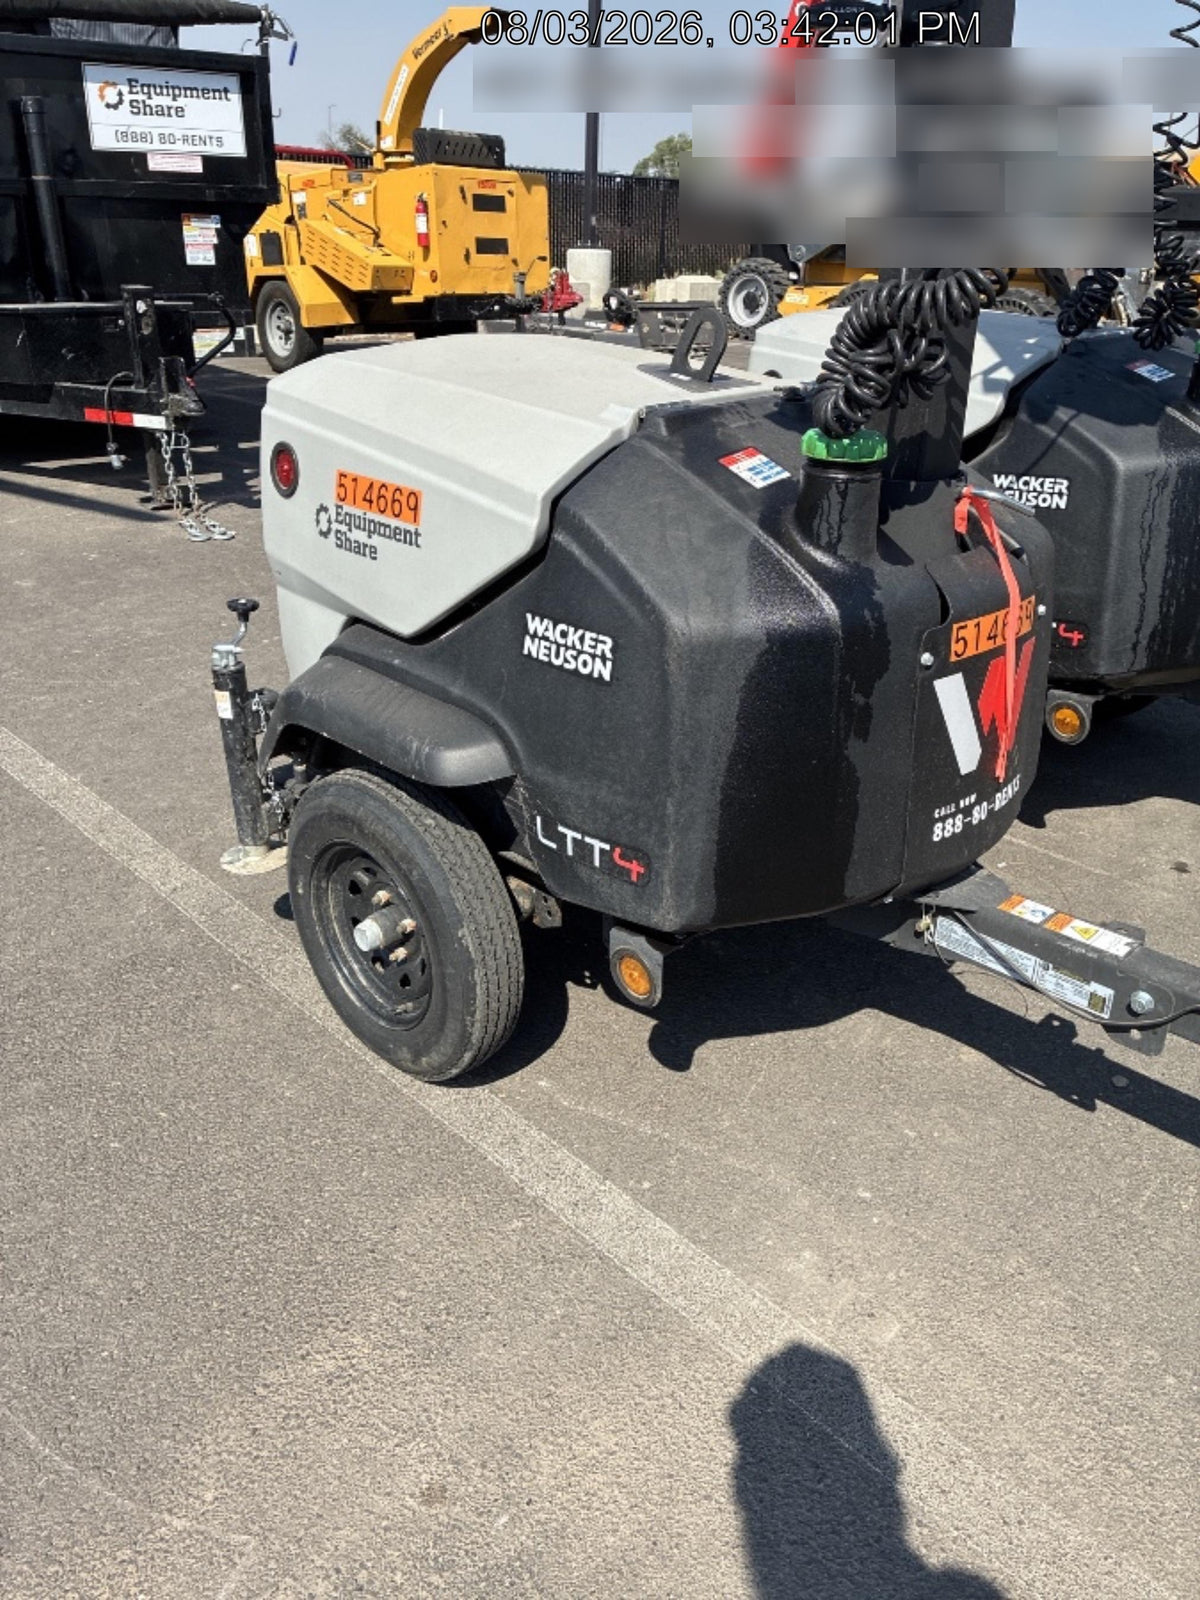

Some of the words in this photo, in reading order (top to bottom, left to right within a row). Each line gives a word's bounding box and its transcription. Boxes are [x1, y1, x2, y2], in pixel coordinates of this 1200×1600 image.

[126, 78, 231, 102] Equipment
[129, 99, 186, 118] Share
[114, 129, 153, 146] (888)
[157, 133, 224, 149] 80-RENTS
[337, 472, 418, 523] 514669
[993, 474, 1069, 496] WACKER
[334, 503, 422, 548] Equipment
[334, 528, 378, 561] Share
[525, 612, 613, 660] WACKER
[522, 634, 612, 682] NEUSON
[934, 803, 956, 819] CALL
